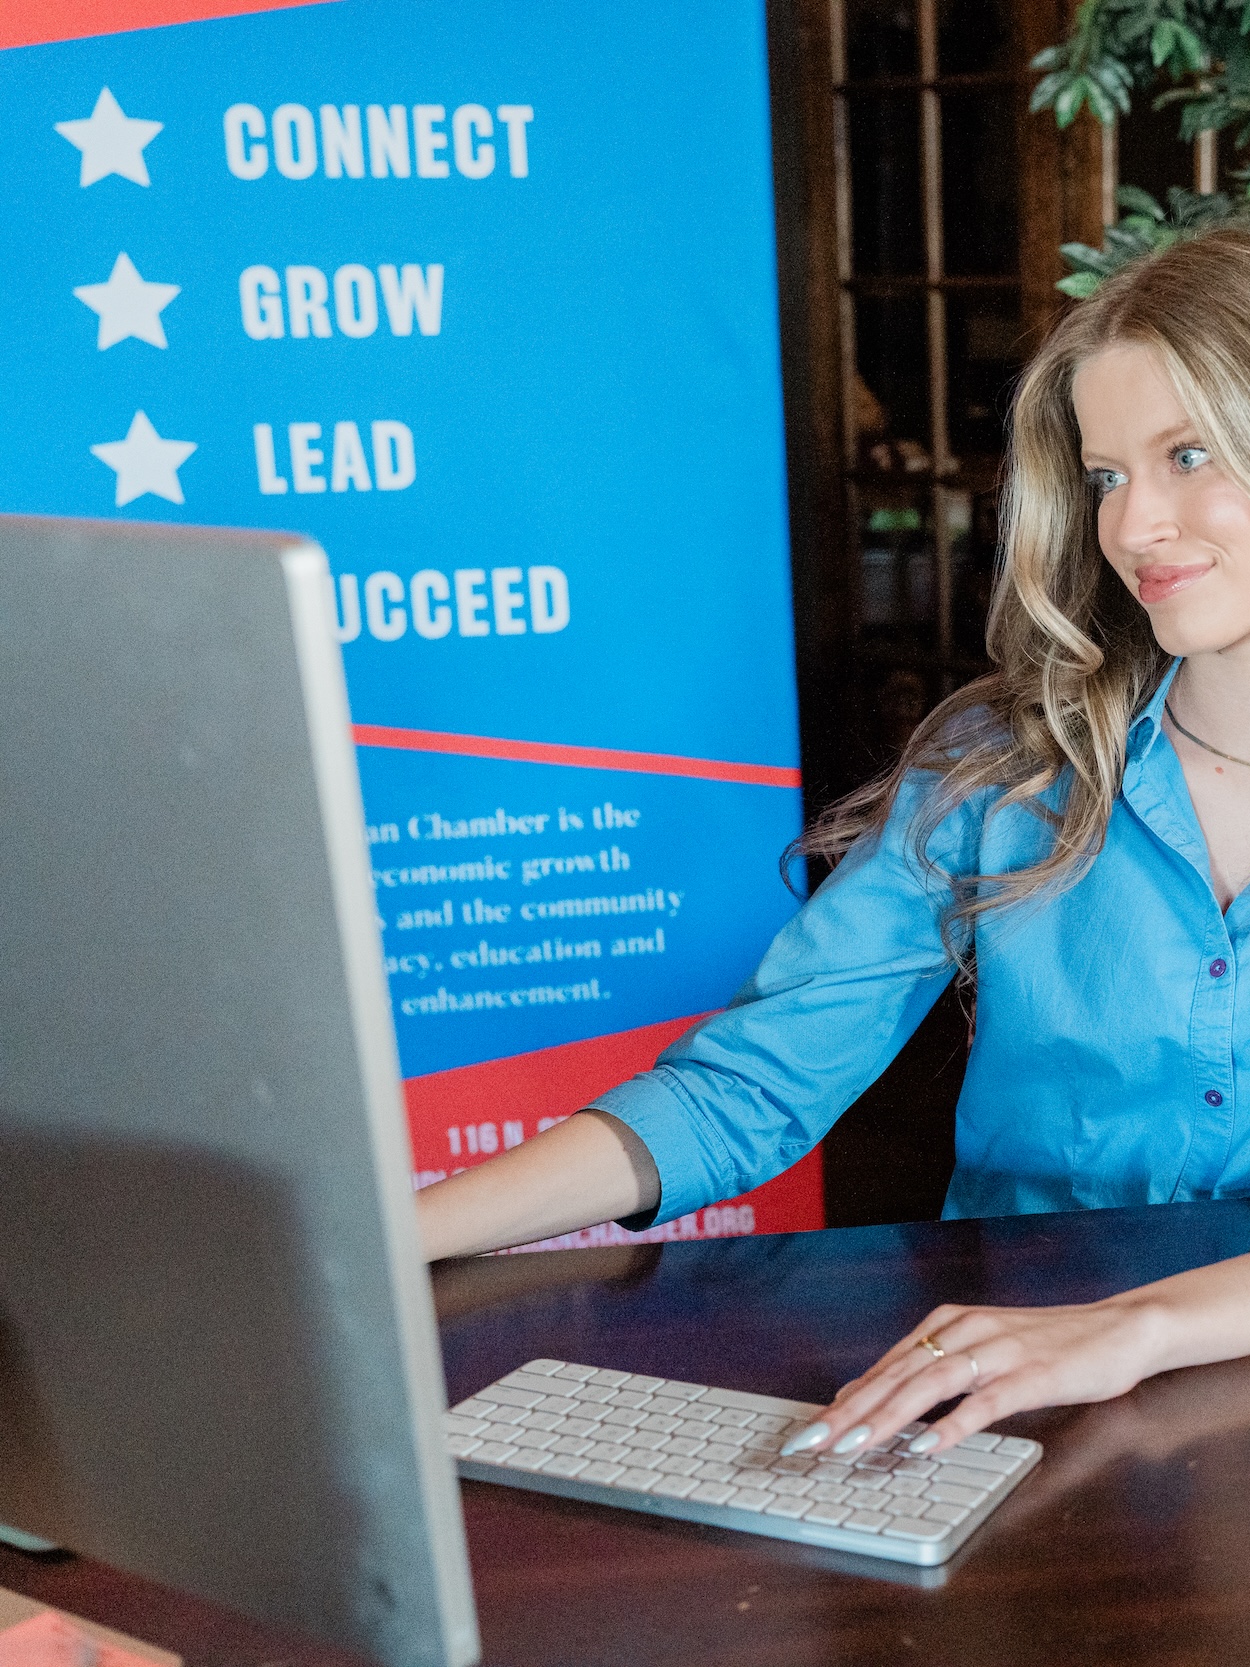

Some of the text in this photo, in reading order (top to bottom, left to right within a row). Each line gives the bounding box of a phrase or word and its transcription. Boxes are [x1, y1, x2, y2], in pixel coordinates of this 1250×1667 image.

[222, 103, 534, 180] CONNECT
[238, 263, 445, 340] GROW
[253, 420, 417, 496] LEAD
[331, 565, 571, 644] UCCEED
[408, 808, 550, 841] Chamber
[557, 807, 584, 832] is
[592, 801, 641, 830] the
[521, 844, 631, 886] growth
[396, 900, 453, 930] and
[462, 897, 511, 925] the
[520, 887, 686, 922] community
[450, 937, 602, 970] education
[611, 927, 666, 957] and
[401, 978, 611, 1016] enhancement.
[447, 1122, 499, 1155] 116
